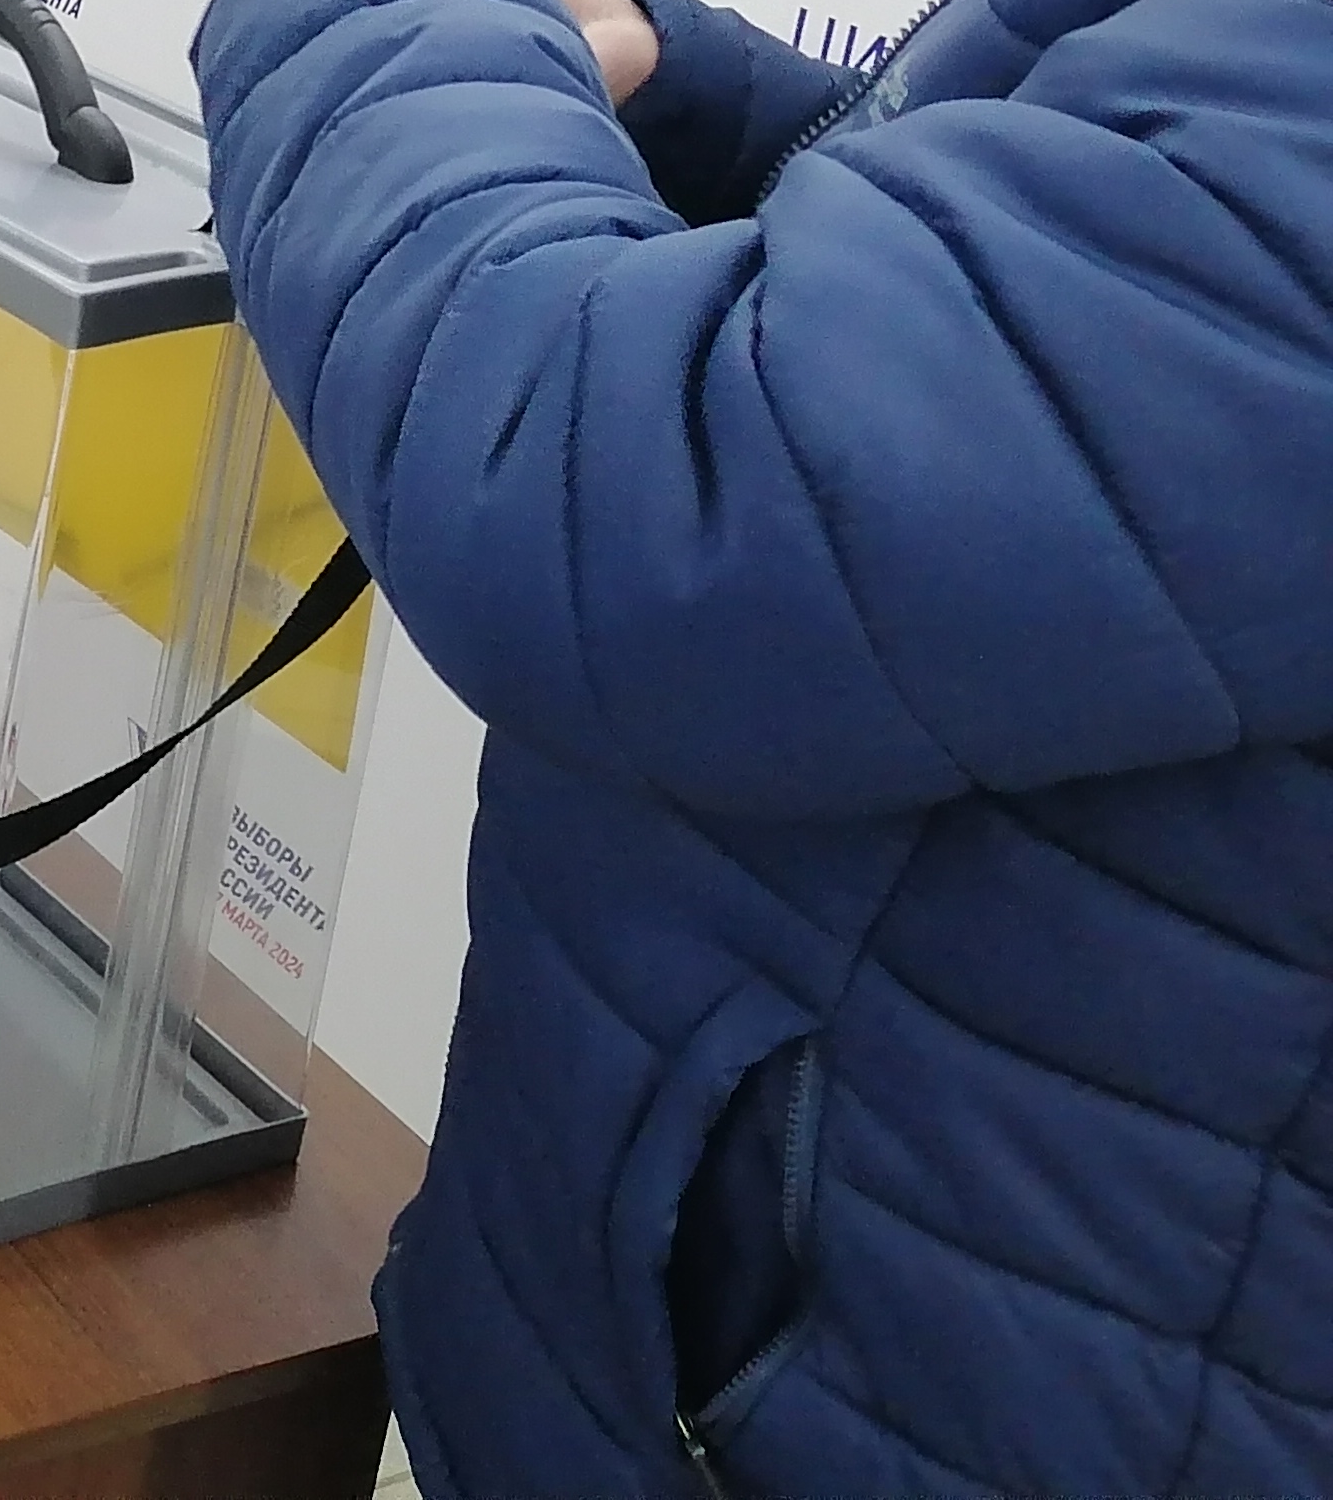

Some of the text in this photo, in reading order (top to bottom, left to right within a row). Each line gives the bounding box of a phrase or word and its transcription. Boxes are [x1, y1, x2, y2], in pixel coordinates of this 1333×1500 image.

[220, 868, 276, 921] ССИИ
[221, 900, 305, 980] МАРТА 2024
